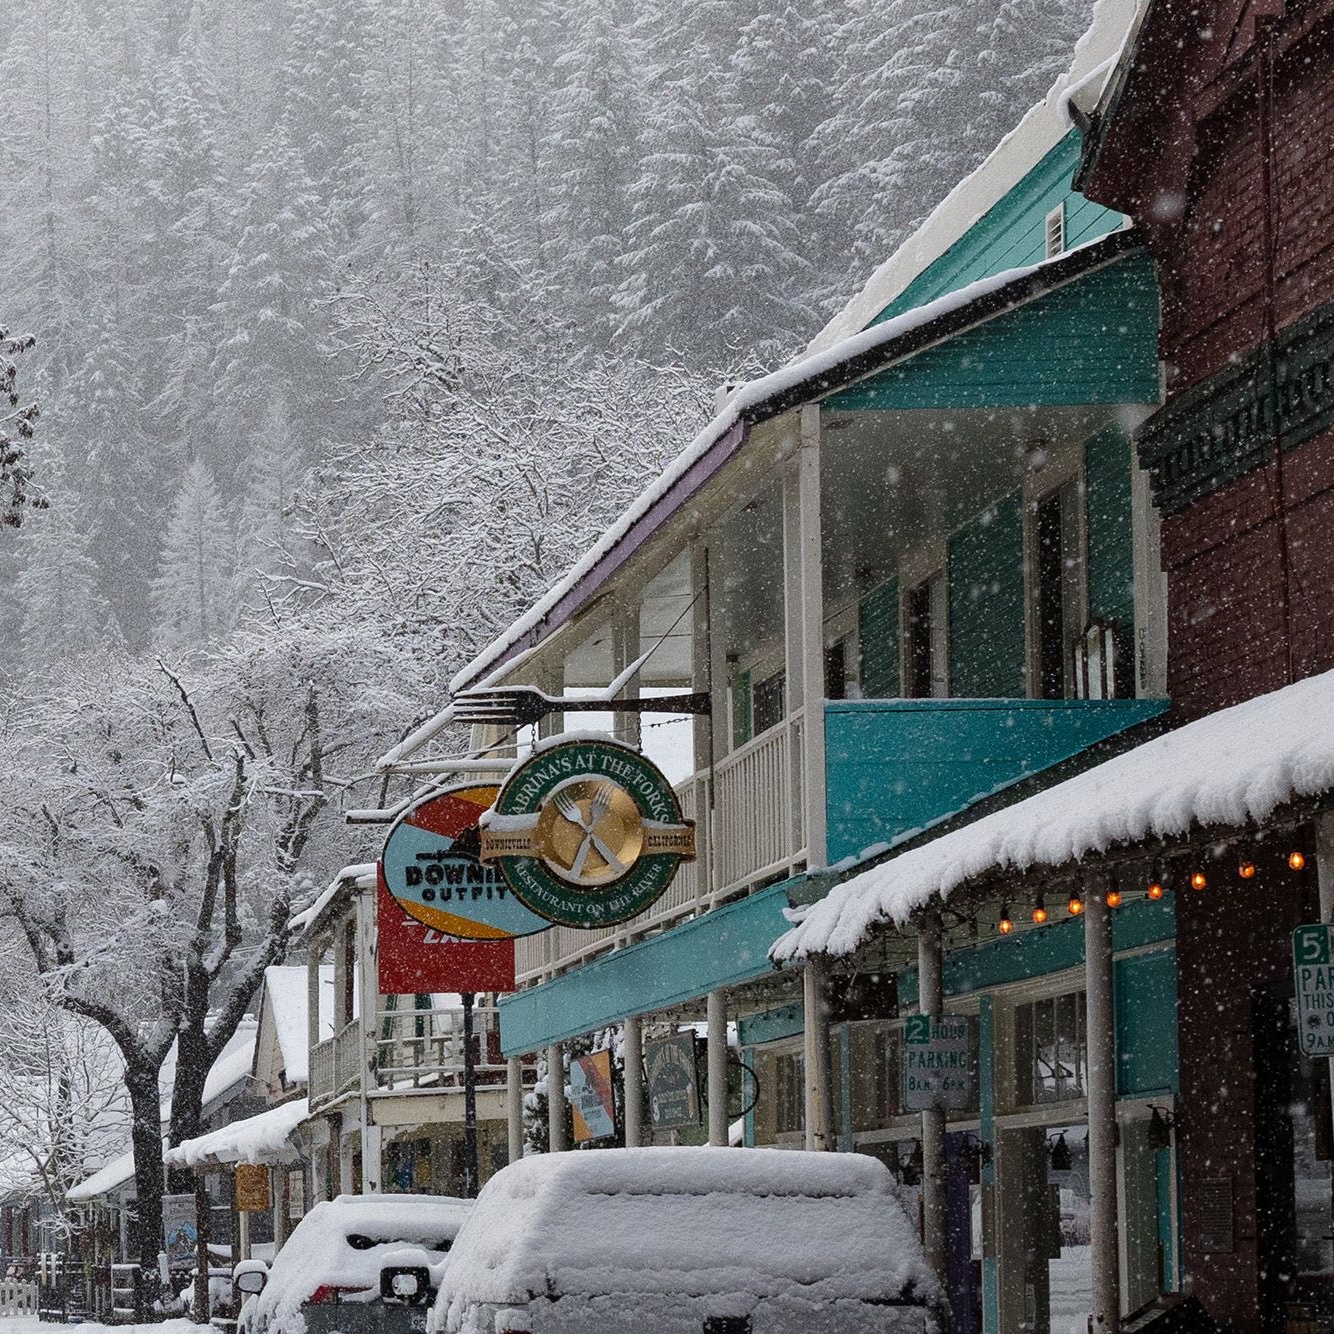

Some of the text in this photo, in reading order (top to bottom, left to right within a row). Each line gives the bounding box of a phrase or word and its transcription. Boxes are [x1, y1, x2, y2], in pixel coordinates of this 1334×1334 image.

[512, 754, 669, 824] ABRINA'S AT THE FORKS
[485, 835, 693, 851] DOWNIEVILLE CALIFORNIA
[513, 861, 663, 914] RESTAURANT ON THE RIVER
[1302, 932, 1322, 960] 5
[1303, 992, 1334, 1010] THIS
[907, 1019, 966, 1040] 2 HOUR
[908, 1051, 967, 1069] PARKING
